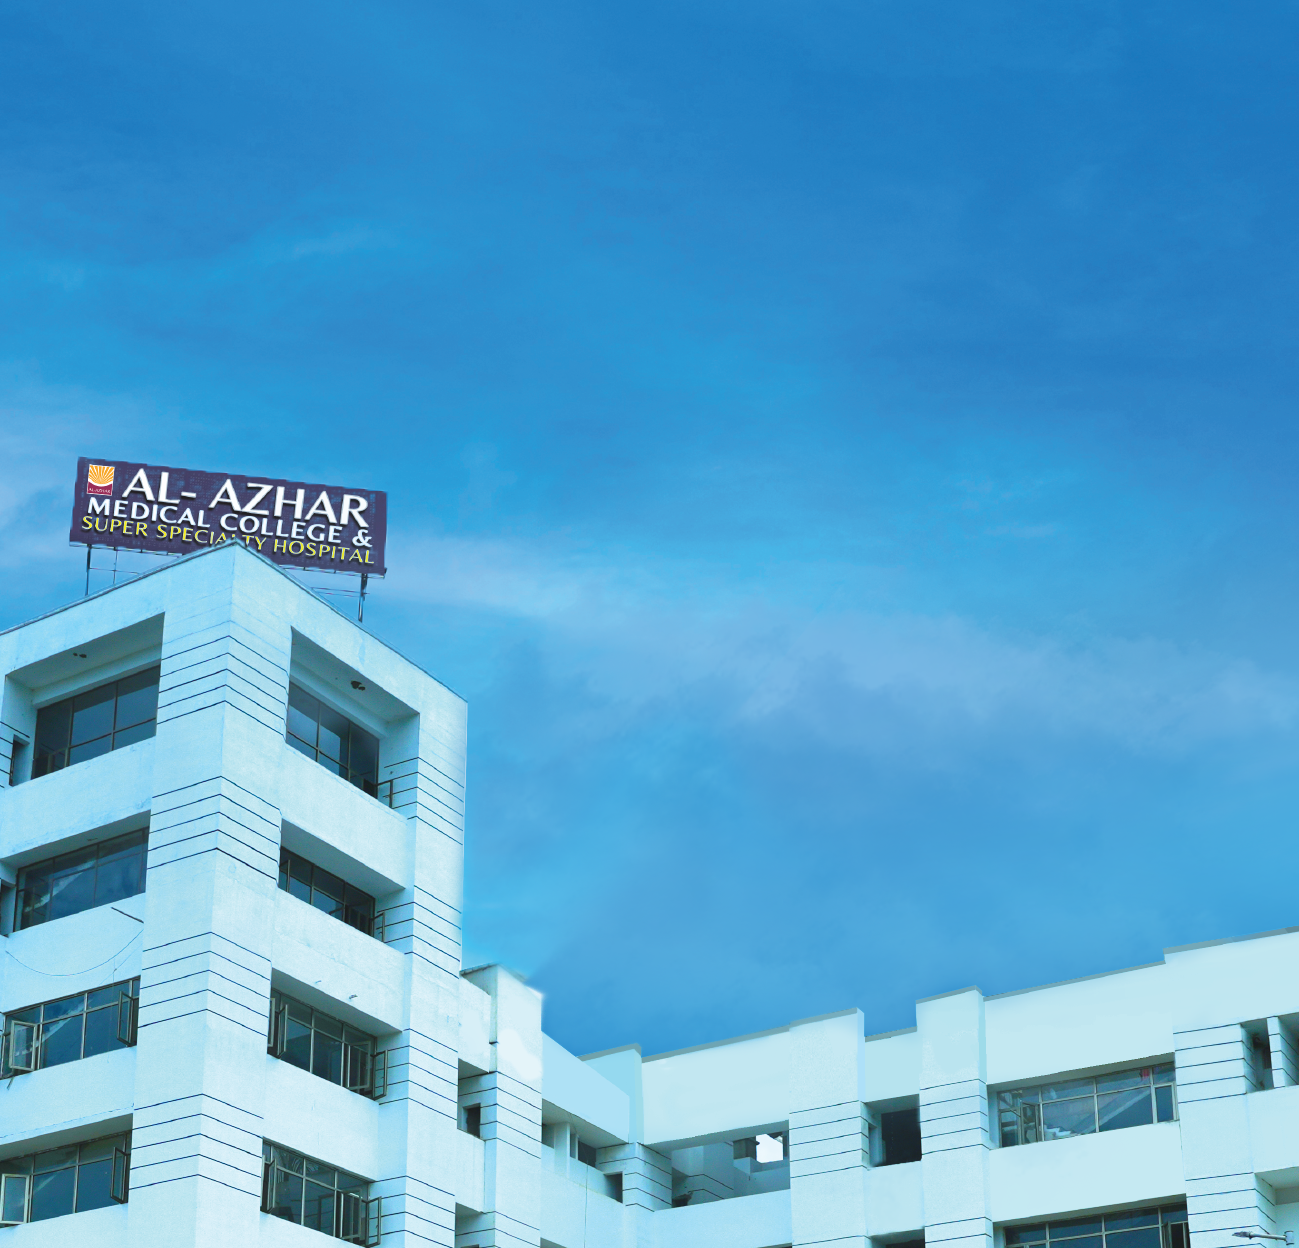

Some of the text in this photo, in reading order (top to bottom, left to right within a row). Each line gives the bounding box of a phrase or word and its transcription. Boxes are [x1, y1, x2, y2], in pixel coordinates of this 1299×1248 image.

[87, 497, 373, 548] MEDICAL COLLEGE &
[208, 478, 370, 528] AZHAR
[81, 516, 375, 564] SUPER SPECIATY HOSPITAL
